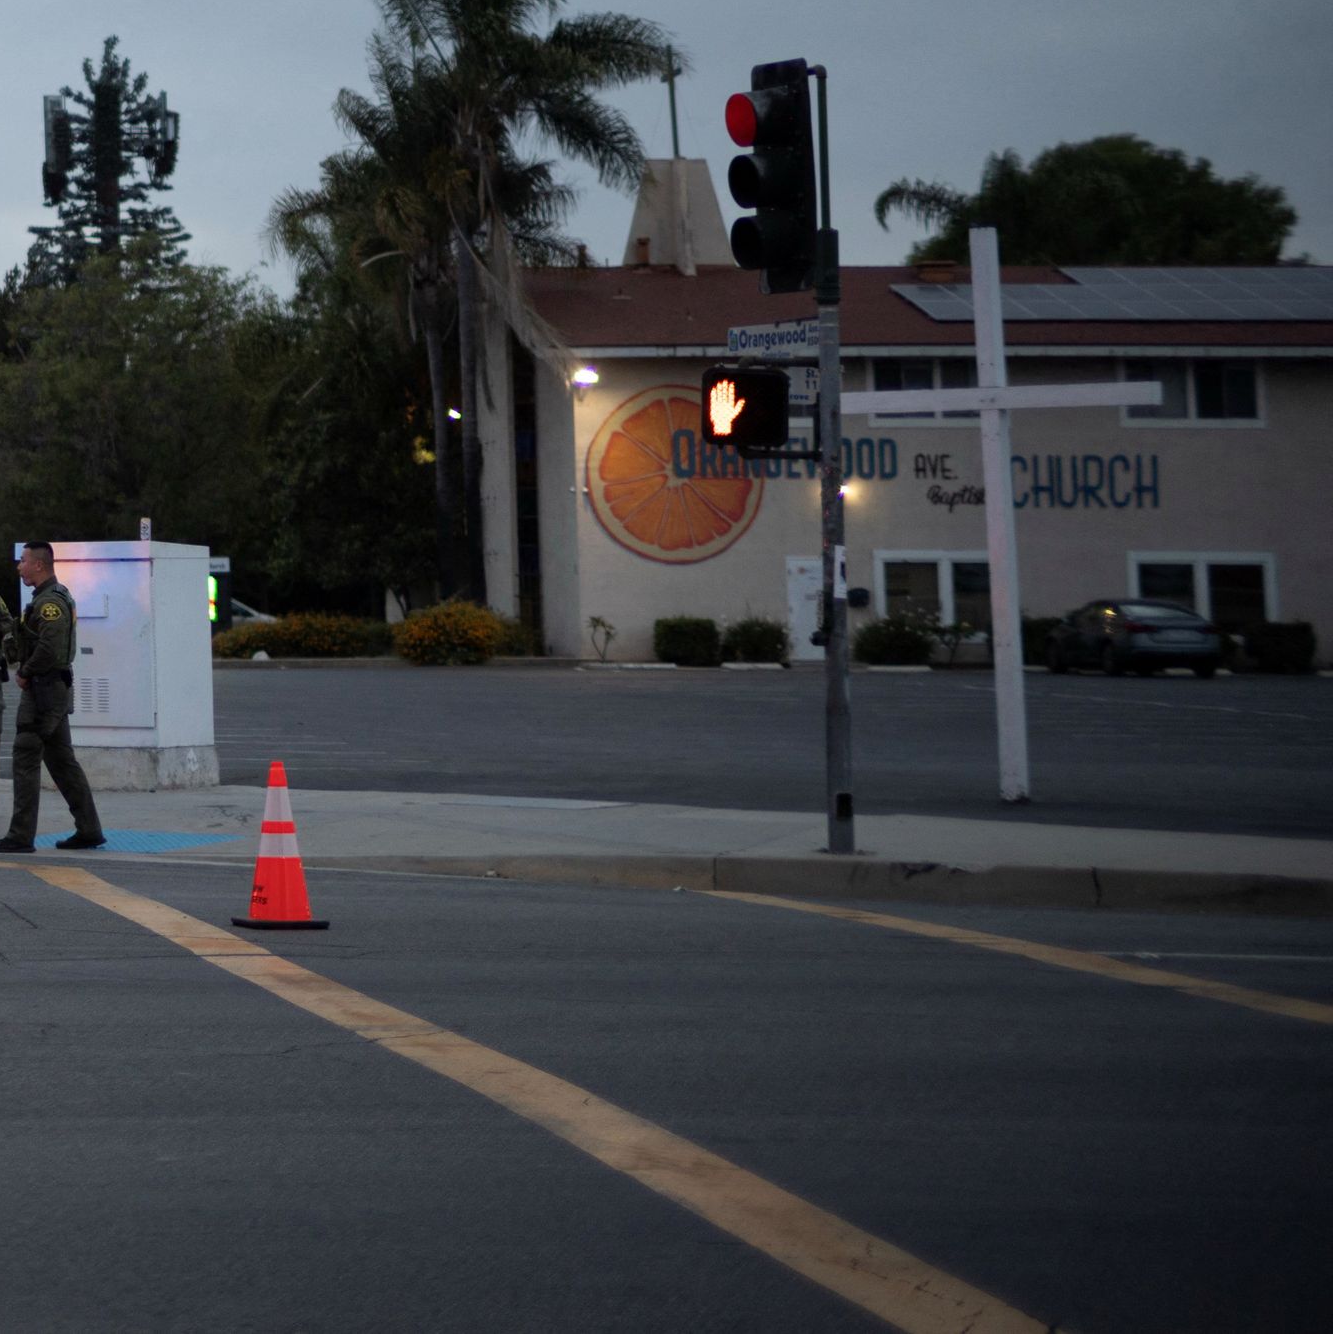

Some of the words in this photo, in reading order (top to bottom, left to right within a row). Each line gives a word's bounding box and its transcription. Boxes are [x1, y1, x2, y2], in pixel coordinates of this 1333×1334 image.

[739, 326, 806, 350] Orangewood
[805, 368, 818, 378] St.
[914, 453, 958, 480] AVE.
[1011, 454, 1160, 509] CHURCH
[926, 484, 985, 513] Baptis
